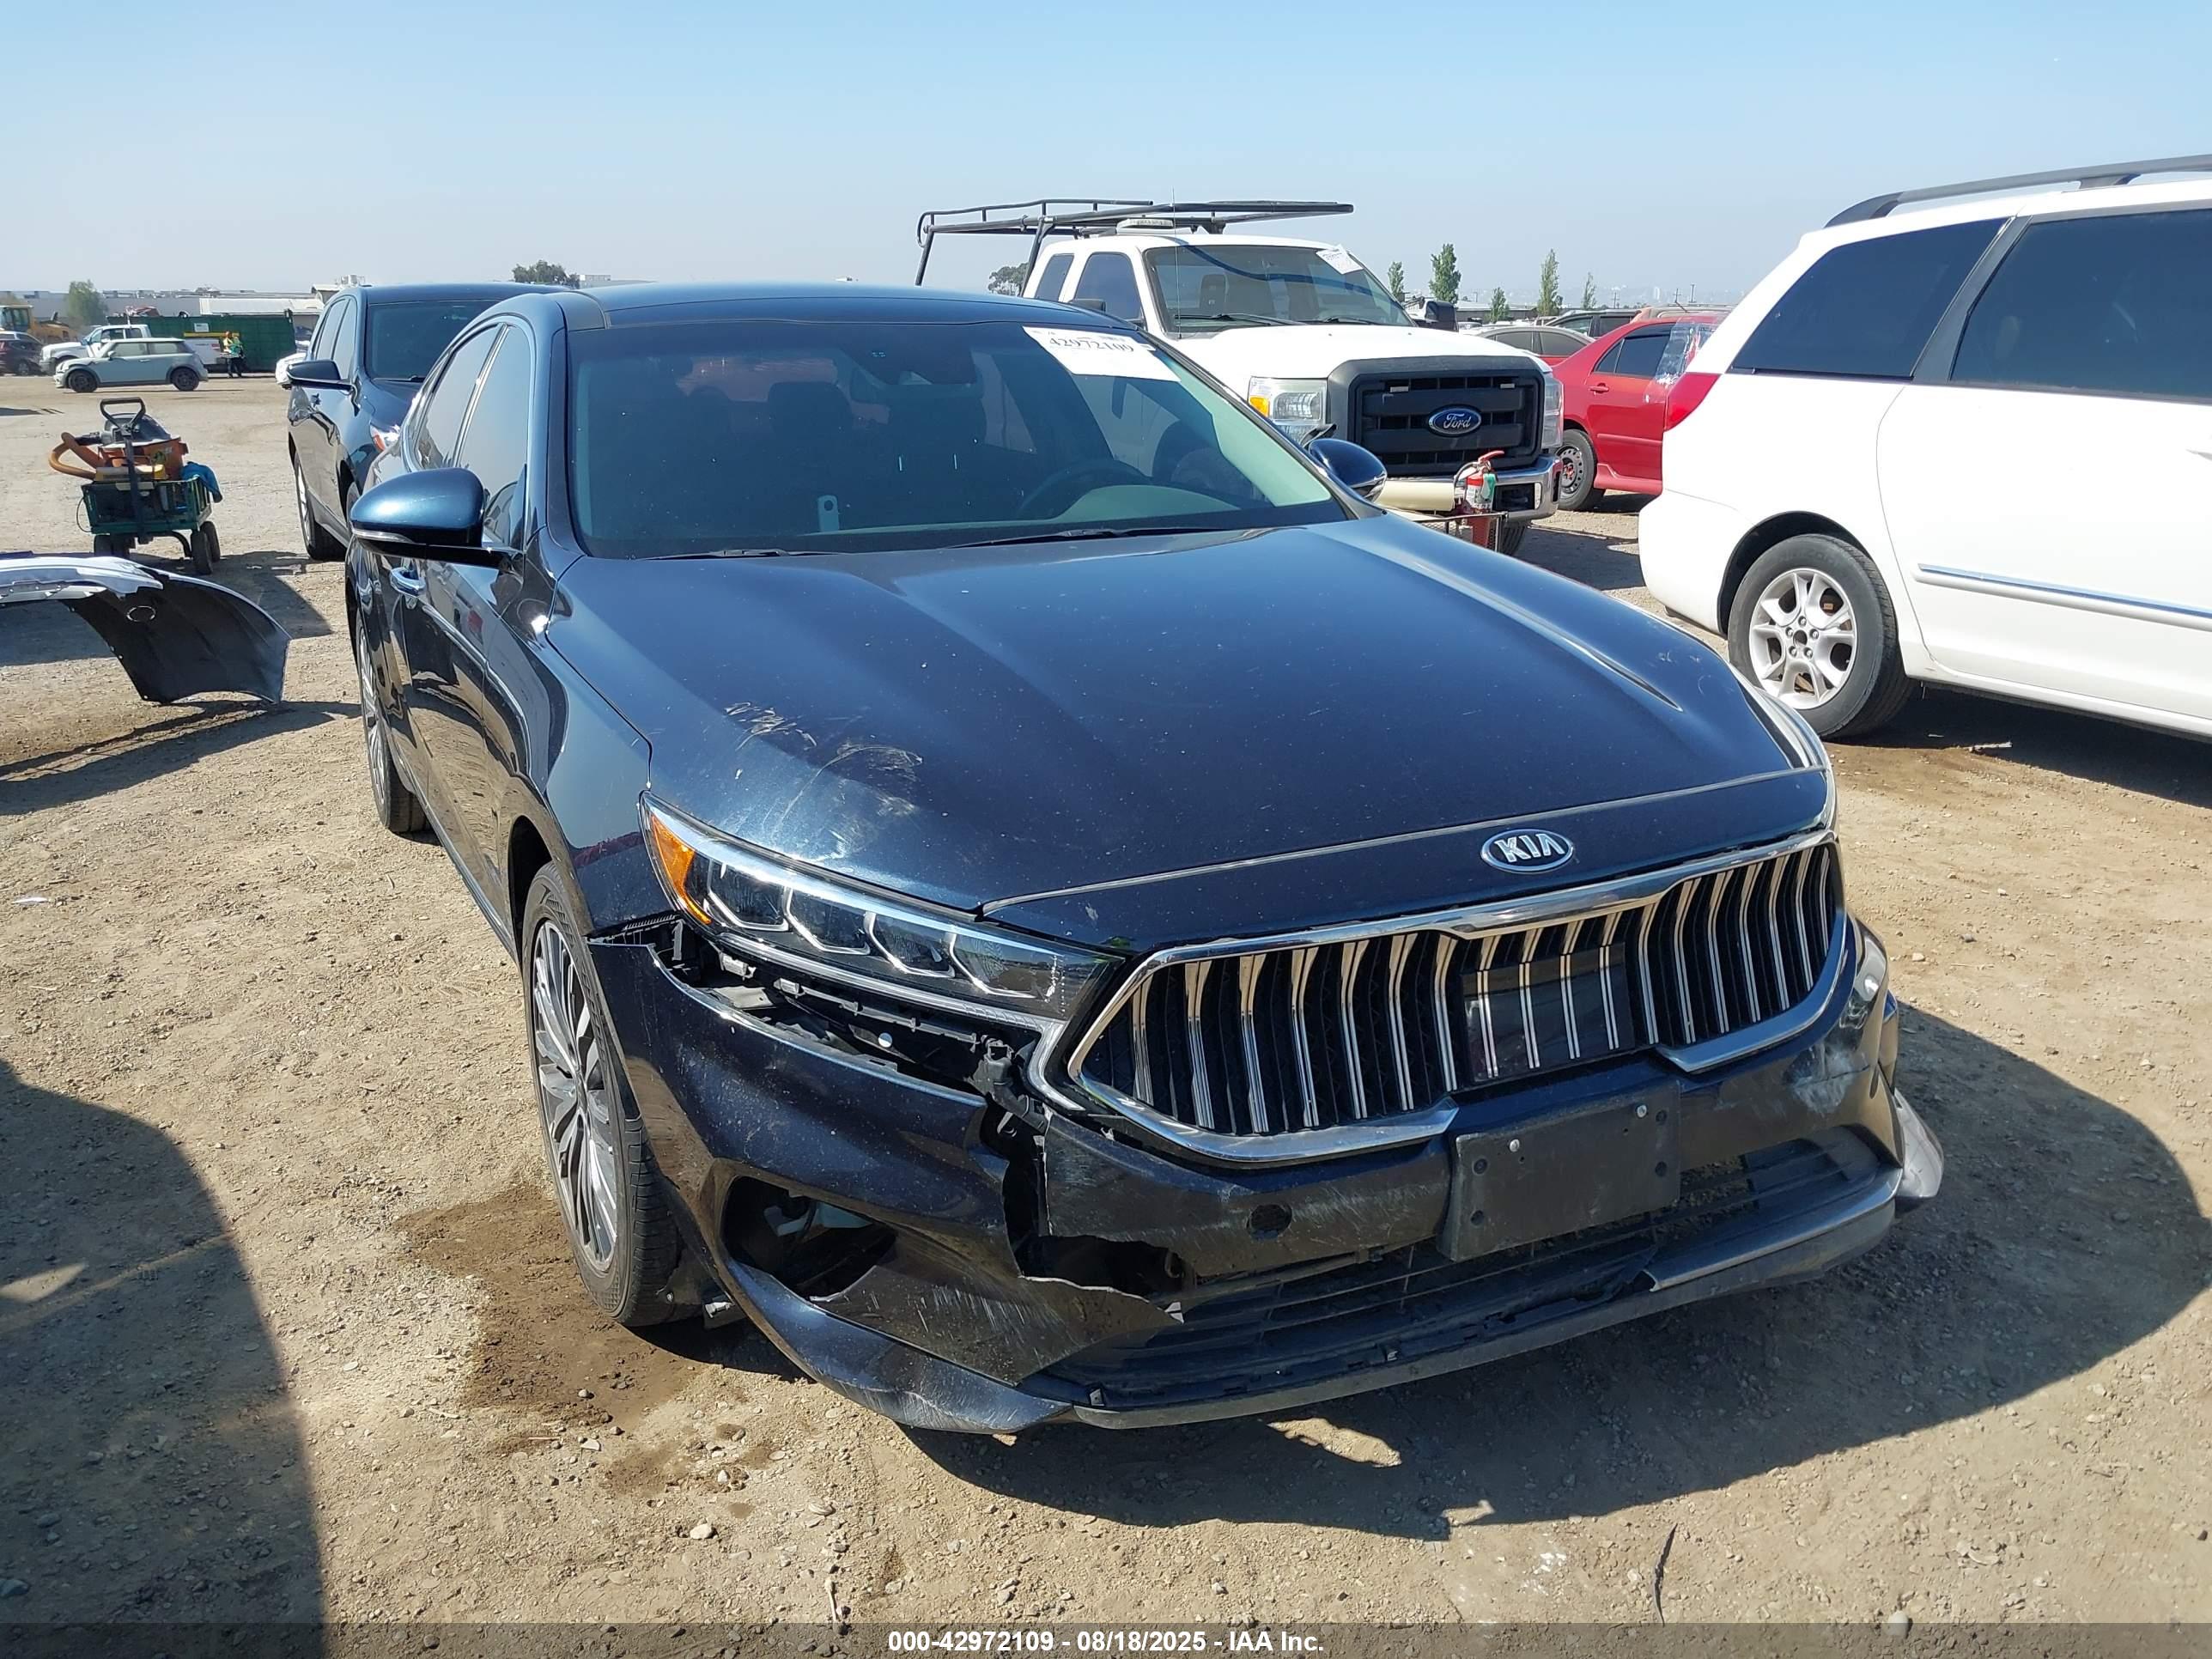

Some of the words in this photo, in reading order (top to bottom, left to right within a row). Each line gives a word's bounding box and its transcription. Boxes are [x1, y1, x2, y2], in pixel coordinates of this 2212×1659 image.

[1049, 337, 1134, 352] 42972109
[1443, 413, 1472, 429] Ford
[1494, 833, 1565, 863] KIA
